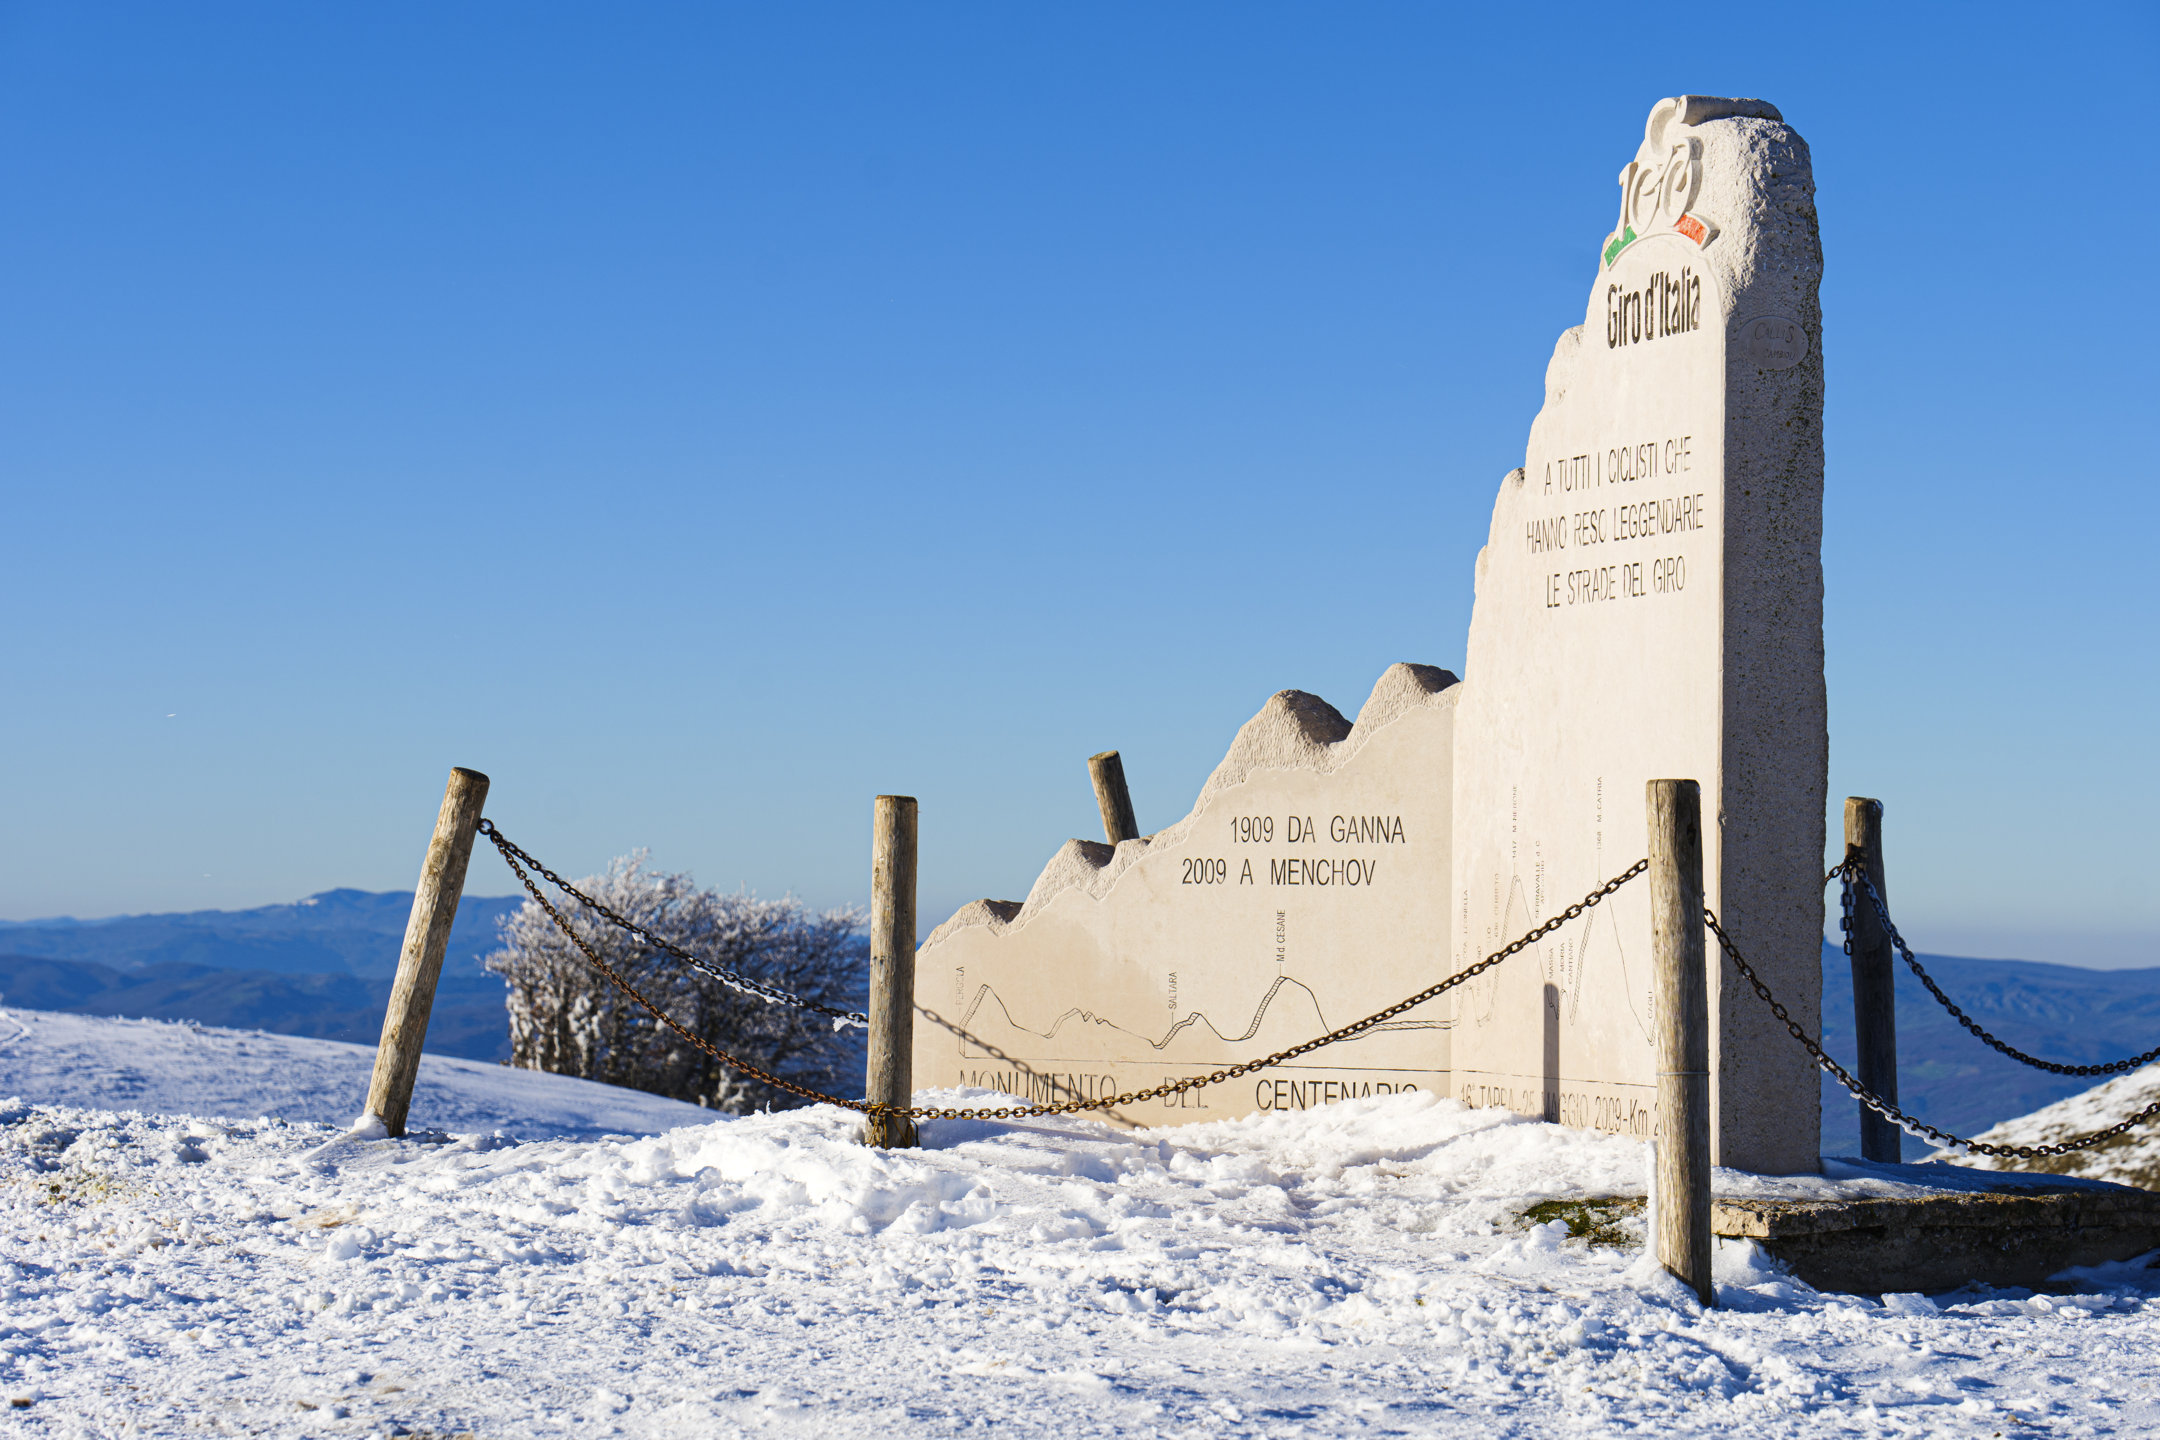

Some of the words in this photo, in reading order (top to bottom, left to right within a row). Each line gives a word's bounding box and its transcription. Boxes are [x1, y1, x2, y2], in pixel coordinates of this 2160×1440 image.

[1607, 282, 1641, 349] Giro
[1644, 265, 1701, 342] d'Italia
[1543, 461, 1553, 496] A
[1558, 453, 1591, 495] TUTTI
[1597, 452, 1600, 487] I
[1608, 441, 1659, 484] CICLISTI
[1665, 435, 1692, 475] CHE
[1526, 515, 1567, 555] HANNO
[1574, 508, 1607, 547] RESO
[1613, 493, 1704, 542] LEGGENDARIE
[1546, 573, 1561, 608] LE
[1567, 565, 1617, 606] STRADE
[1623, 562, 1647, 599] DEL
[1653, 555, 1687, 595] GIRO
[1230, 815, 1275, 844] 1909
[1287, 815, 1316, 844] DA
[1330, 815, 1406, 844] GANNA
[1182, 858, 1227, 885] 2009
[1240, 858, 1254, 885] A
[1270, 858, 1376, 886] MENCHOV
[1277, 909, 1286, 944] CESANE
[956, 965, 966, 1007] PERGOLA
[1168, 971, 1178, 1010] SALTARA
[959, 1069, 1117, 1106] MONUMENTO
